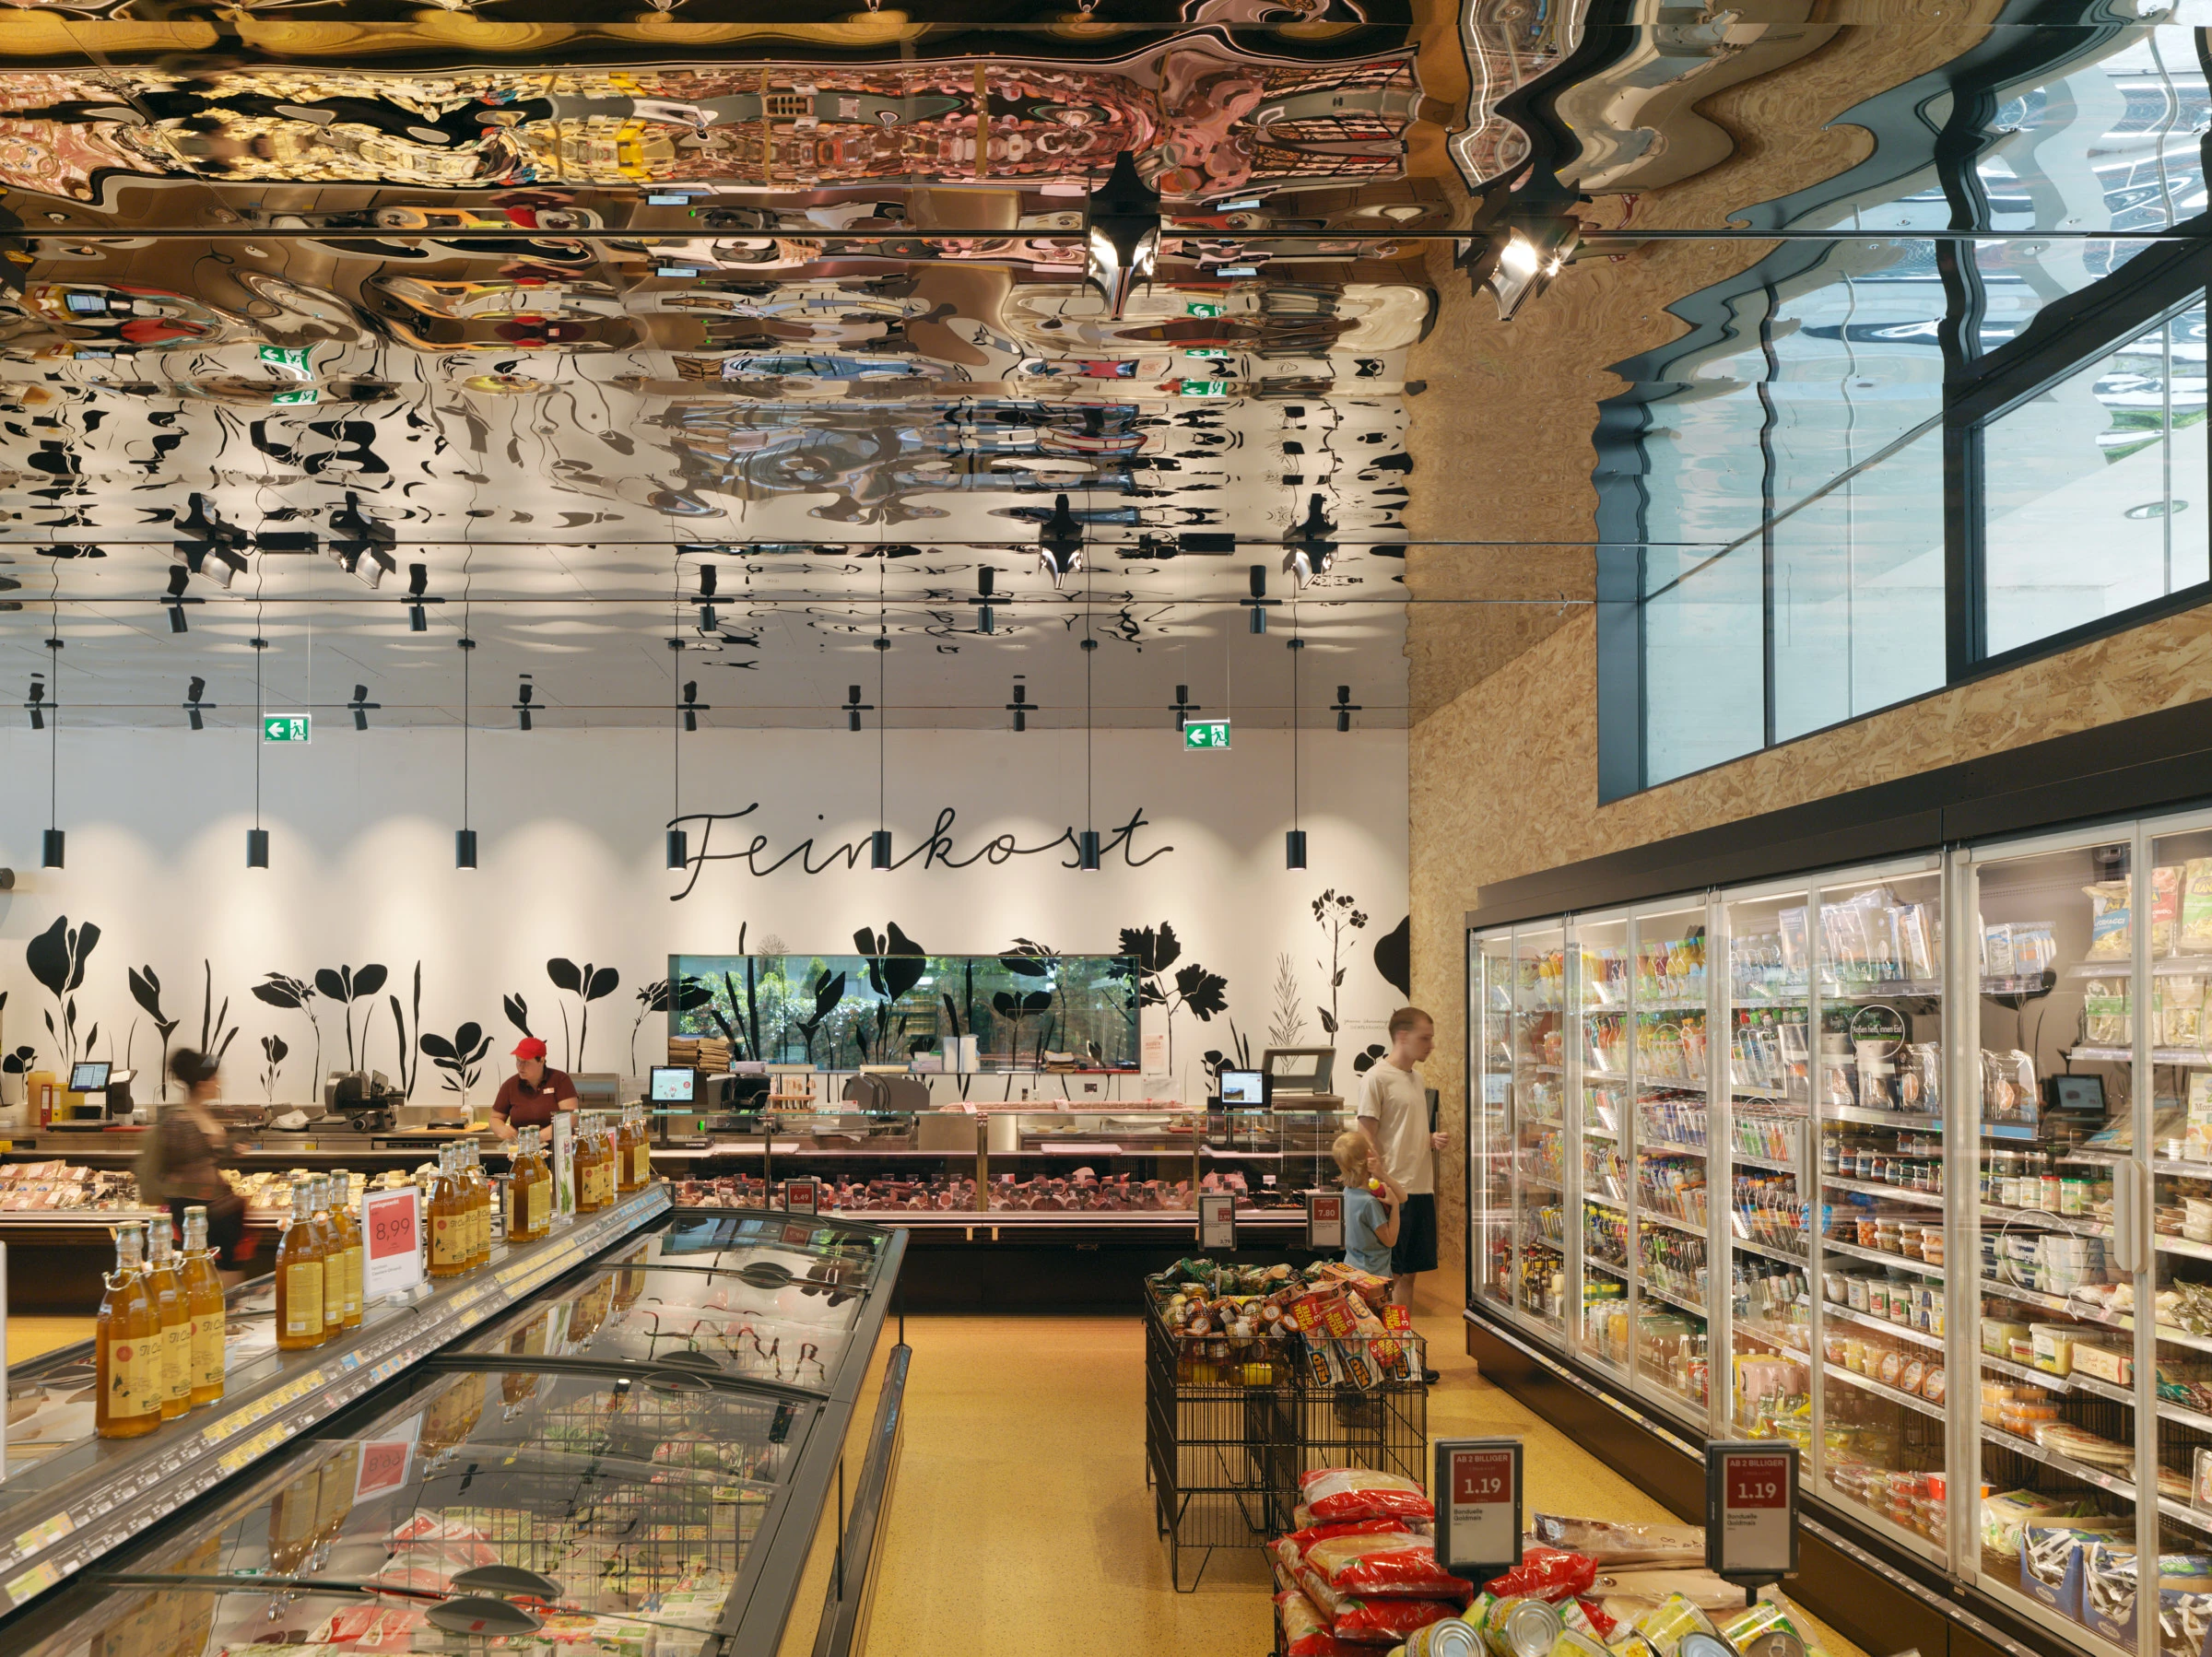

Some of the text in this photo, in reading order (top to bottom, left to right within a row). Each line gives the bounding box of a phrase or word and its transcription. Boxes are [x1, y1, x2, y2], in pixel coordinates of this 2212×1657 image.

[666, 803, 1173, 901] Feinkost
[2194, 883, 2212, 893] RAN
[1880, 1024, 1893, 1032] innen
[376, 1217, 410, 1241] 8,99
[1301, 1304, 1314, 1325] OFFER
[1347, 1294, 1371, 1318] RIO
[1293, 1303, 1309, 1331] SPECIAL
[1313, 1314, 1322, 1322] 3
[1325, 1312, 1343, 1338] SPECIAL
[1333, 1311, 1347, 1332] OFFER
[1346, 1319, 1355, 1327] 3
[1384, 1306, 1394, 1330] SPECIAL
[1391, 1308, 1401, 1327] OFFER
[1312, 1352, 1328, 1383] RIO
[1349, 1357, 1370, 1388] RIO
[1475, 1454, 1509, 1463] BILLIGER
[1748, 1459, 1784, 1467] BILLIGER
[1465, 1477, 1501, 1494] 1.19
[1737, 1482, 1777, 1498] 1.19
